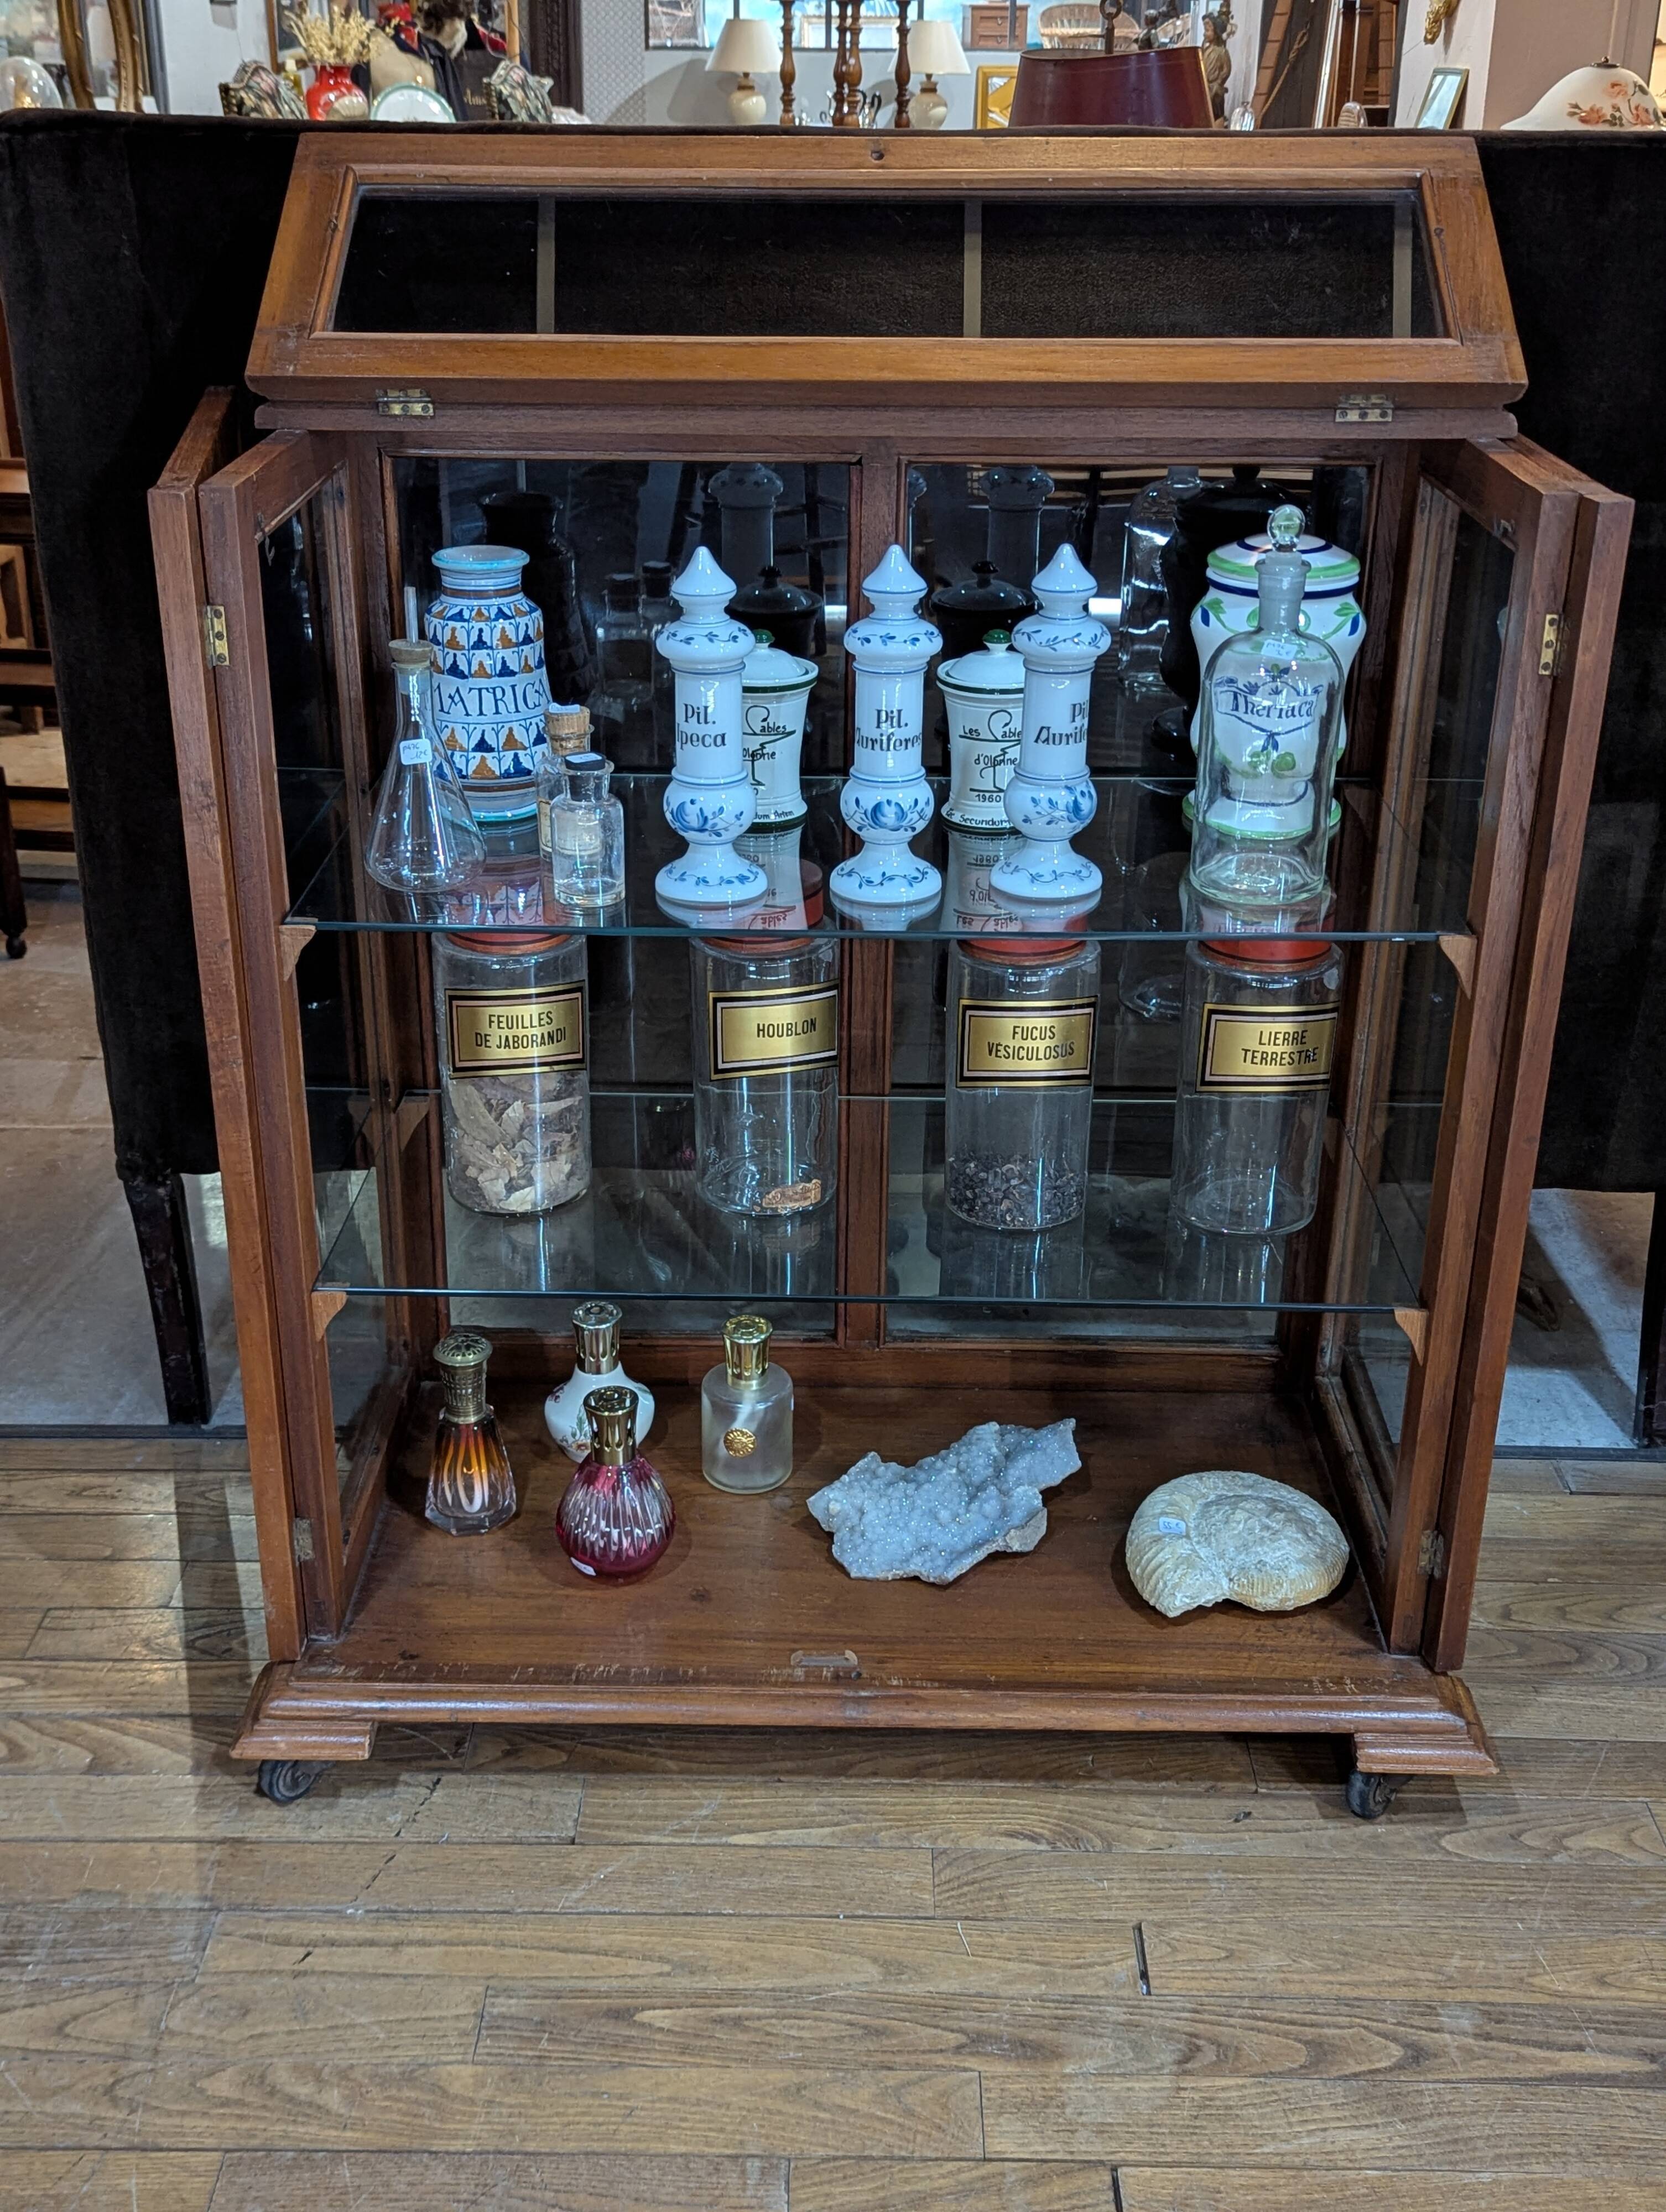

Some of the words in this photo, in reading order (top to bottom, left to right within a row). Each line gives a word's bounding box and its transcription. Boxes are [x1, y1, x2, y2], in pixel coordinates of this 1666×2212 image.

[683, 703, 716, 725] Pil.
[875, 708, 909, 729] Pil.
[676, 722, 727, 751] Ipeca
[962, 724, 981, 737] Les
[975, 793, 1002, 803] 1960
[488, 1010, 554, 1030] FEUILLES
[756, 1017, 818, 1039] HOUBLON
[475, 1031, 492, 1048] DE
[496, 1026, 567, 1050] JABORANDI
[1012, 1025, 1056, 1041] FUCUS
[1258, 1030, 1309, 1047] LIERRE
[1241, 1046, 1320, 1067] TERRESTRE
